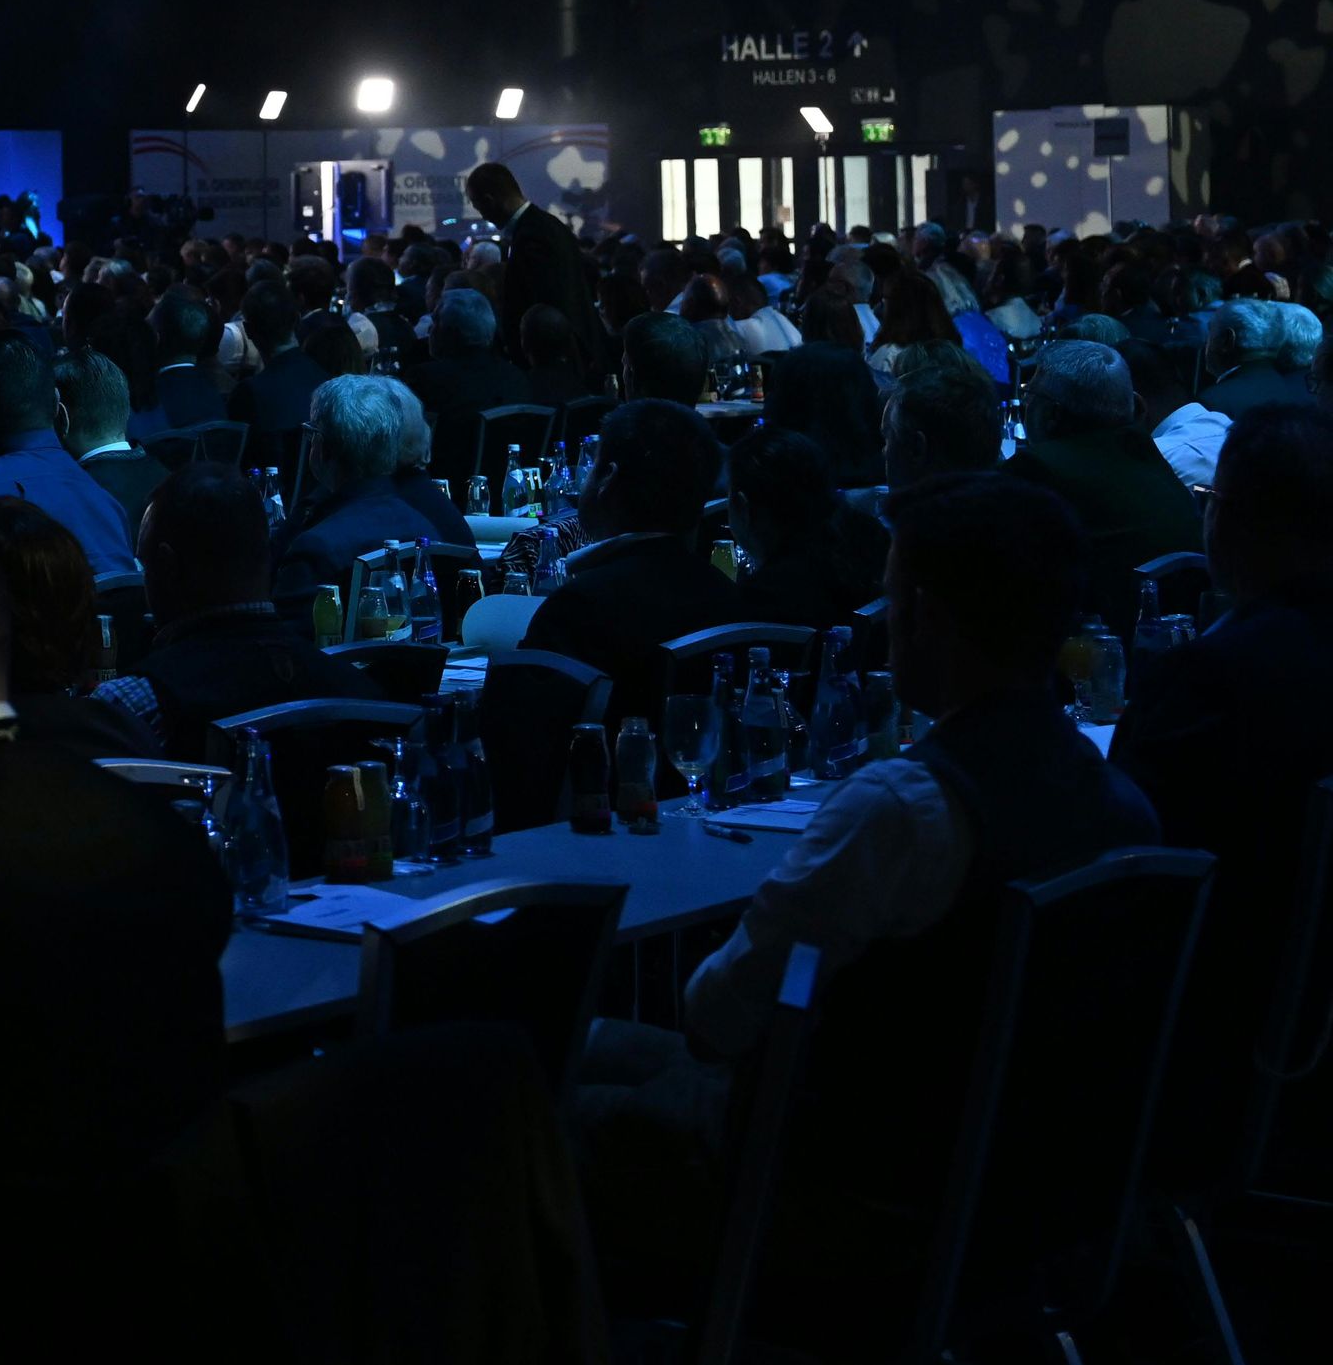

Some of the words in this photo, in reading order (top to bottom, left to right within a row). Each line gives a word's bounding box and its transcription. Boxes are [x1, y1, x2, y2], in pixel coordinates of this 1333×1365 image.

[721, 31, 810, 62] HALLE
[818, 30, 833, 59] 2
[753, 69, 806, 85] HALLEN
[808, 68, 816, 84] 3
